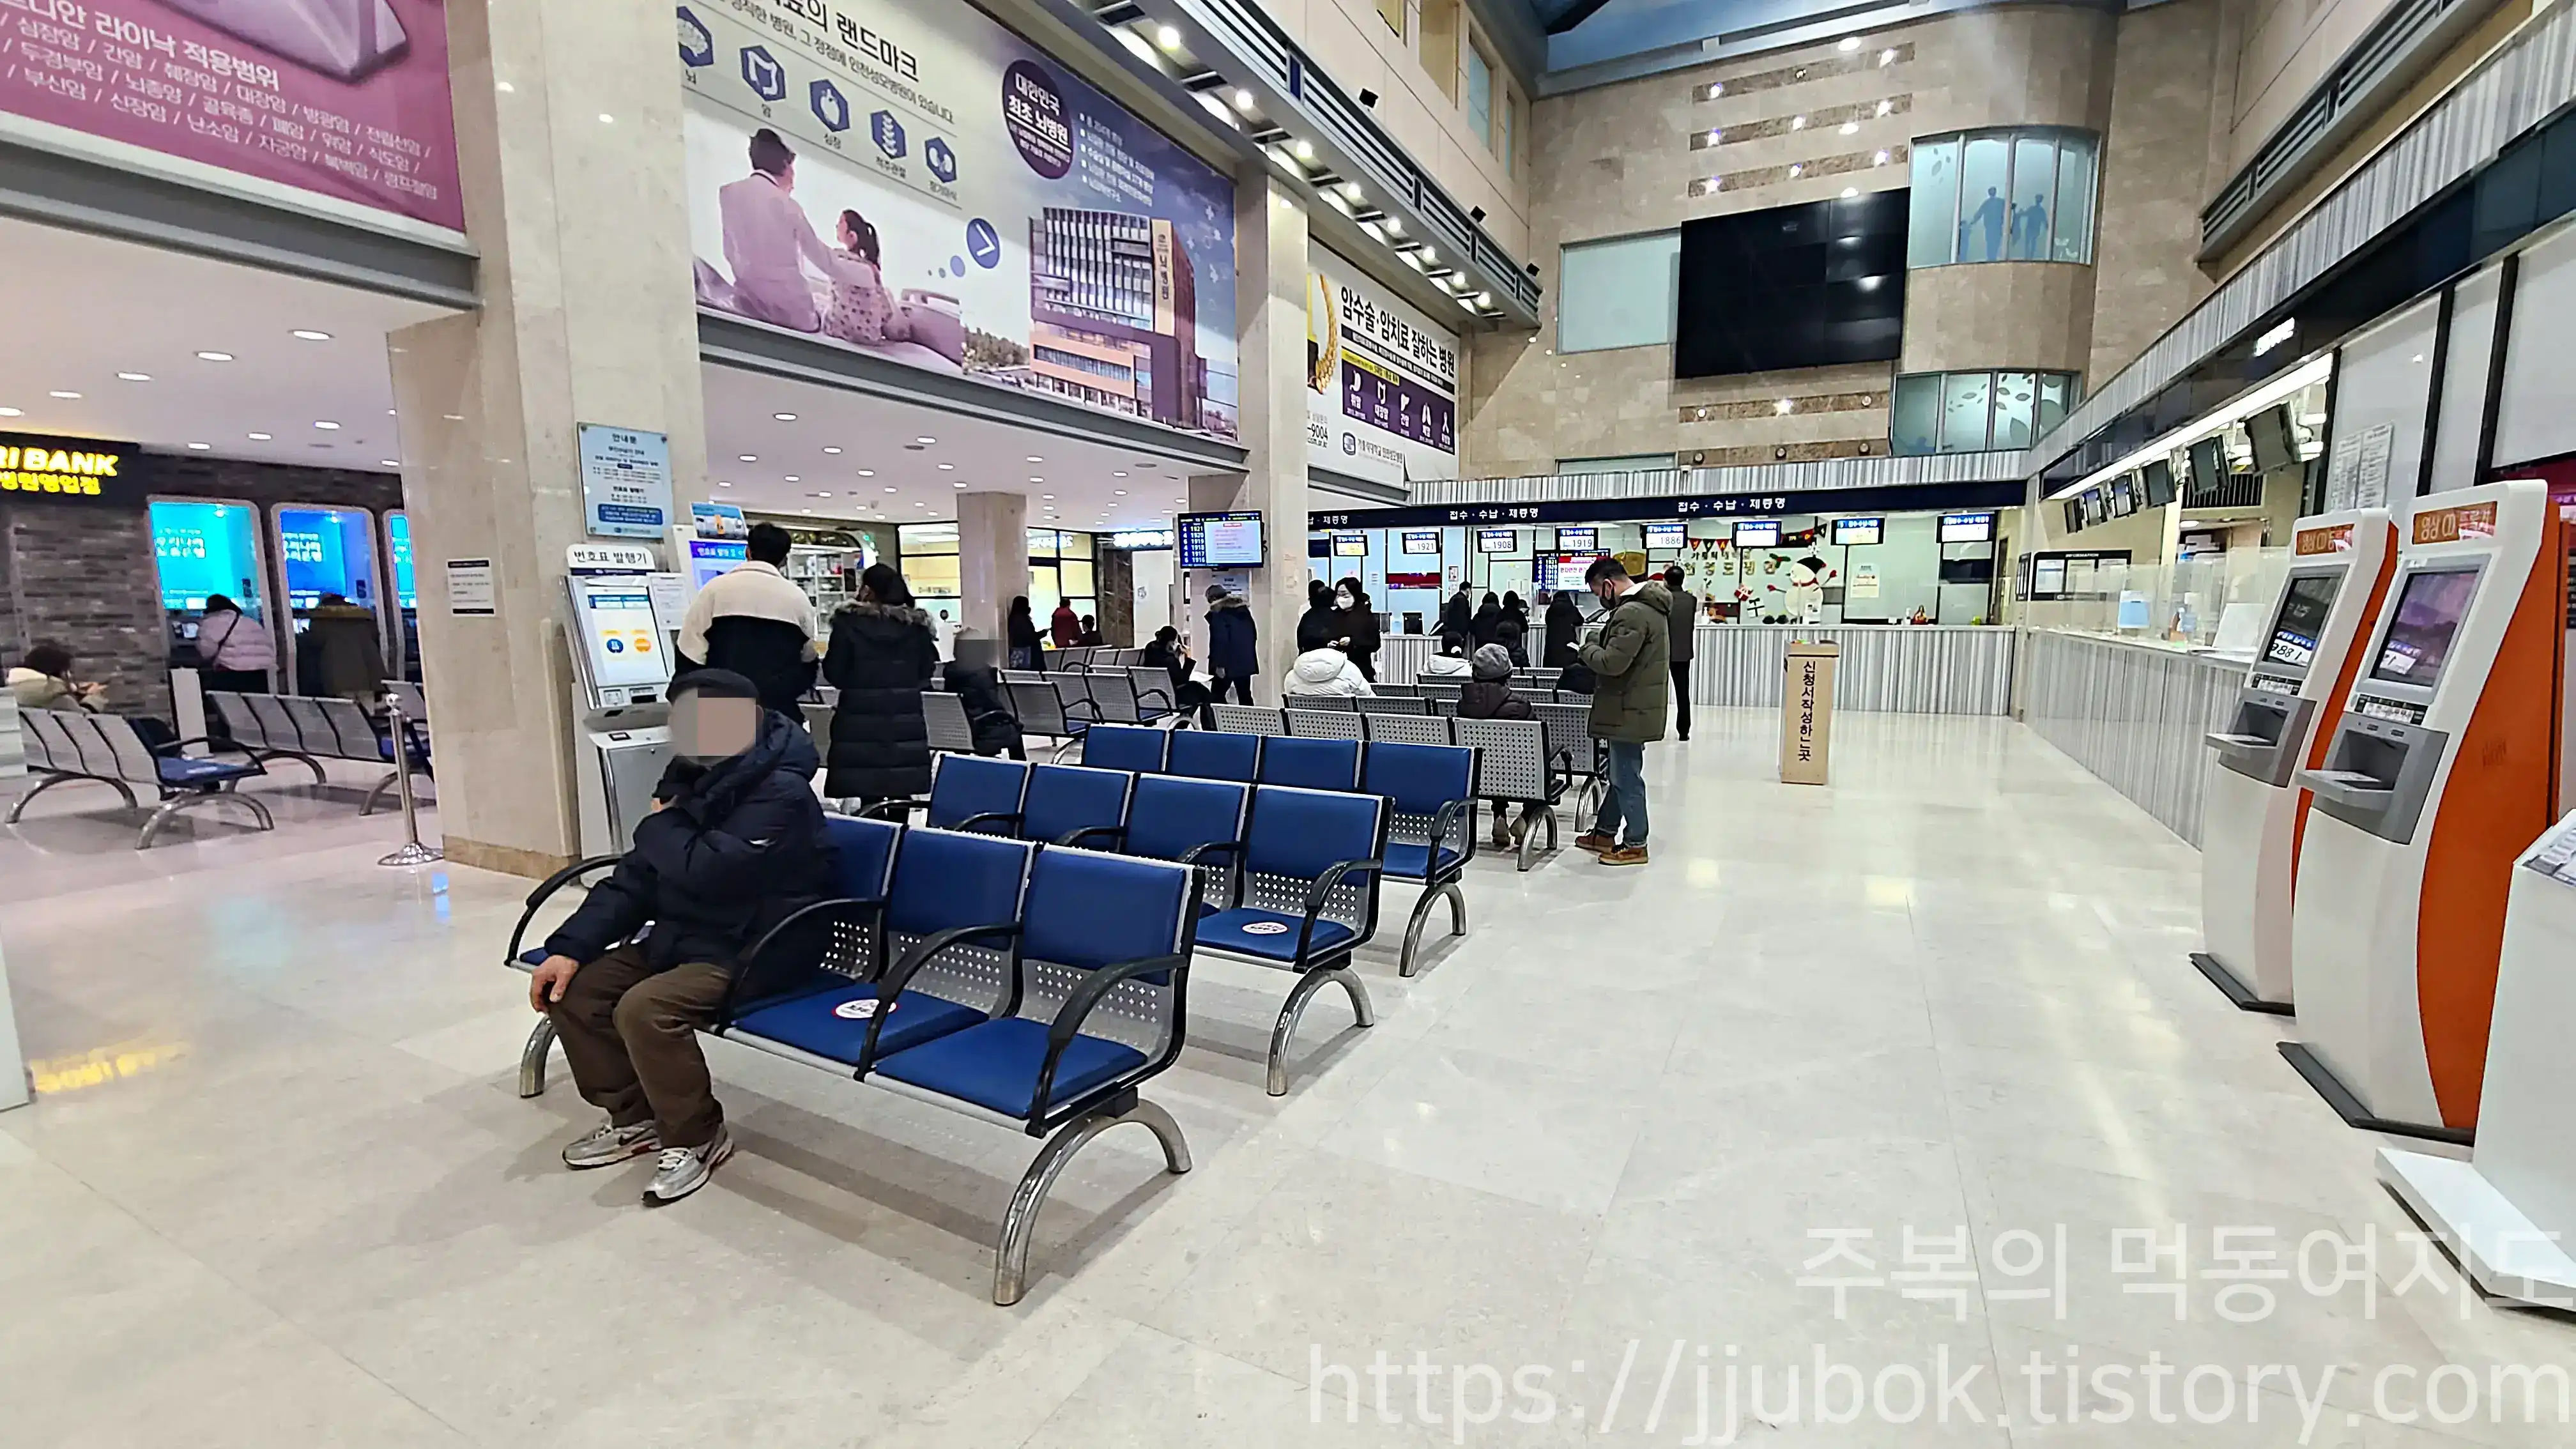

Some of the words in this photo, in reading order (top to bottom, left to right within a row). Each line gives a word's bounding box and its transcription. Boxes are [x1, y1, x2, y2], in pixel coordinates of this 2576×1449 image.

[95, 11, 176, 58] 라이낙
[182, 40, 279, 91] 적용범위
[801, 29, 811, 47] 그
[836, 12, 919, 82] 랜드마크
[103, 42, 143, 70] 간암
[237, 85, 286, 113] 대장암
[1015, 73, 1060, 116] 대한민국
[111, 93, 165, 123] 신장암
[187, 114, 238, 144] 난소암
[259, 134, 306, 161] 자궁암
[1008, 95, 1032, 124] 최초
[1036, 111, 1068, 146] 뇌병원
[1411, 329, 1437, 369] 잘하는
[1439, 346, 1455, 378] 병원
[23, 448, 118, 476] BANK
[1450, 510, 1468, 519] 접수
[1479, 509, 1498, 519] 수납
[1678, 502, 1699, 512] 접수
[1713, 500, 1736, 511] 수납
[574, 550, 610, 564] 번호표
[613, 551, 647, 565] 발행기
[1573, 539, 1591, 548] 1919
